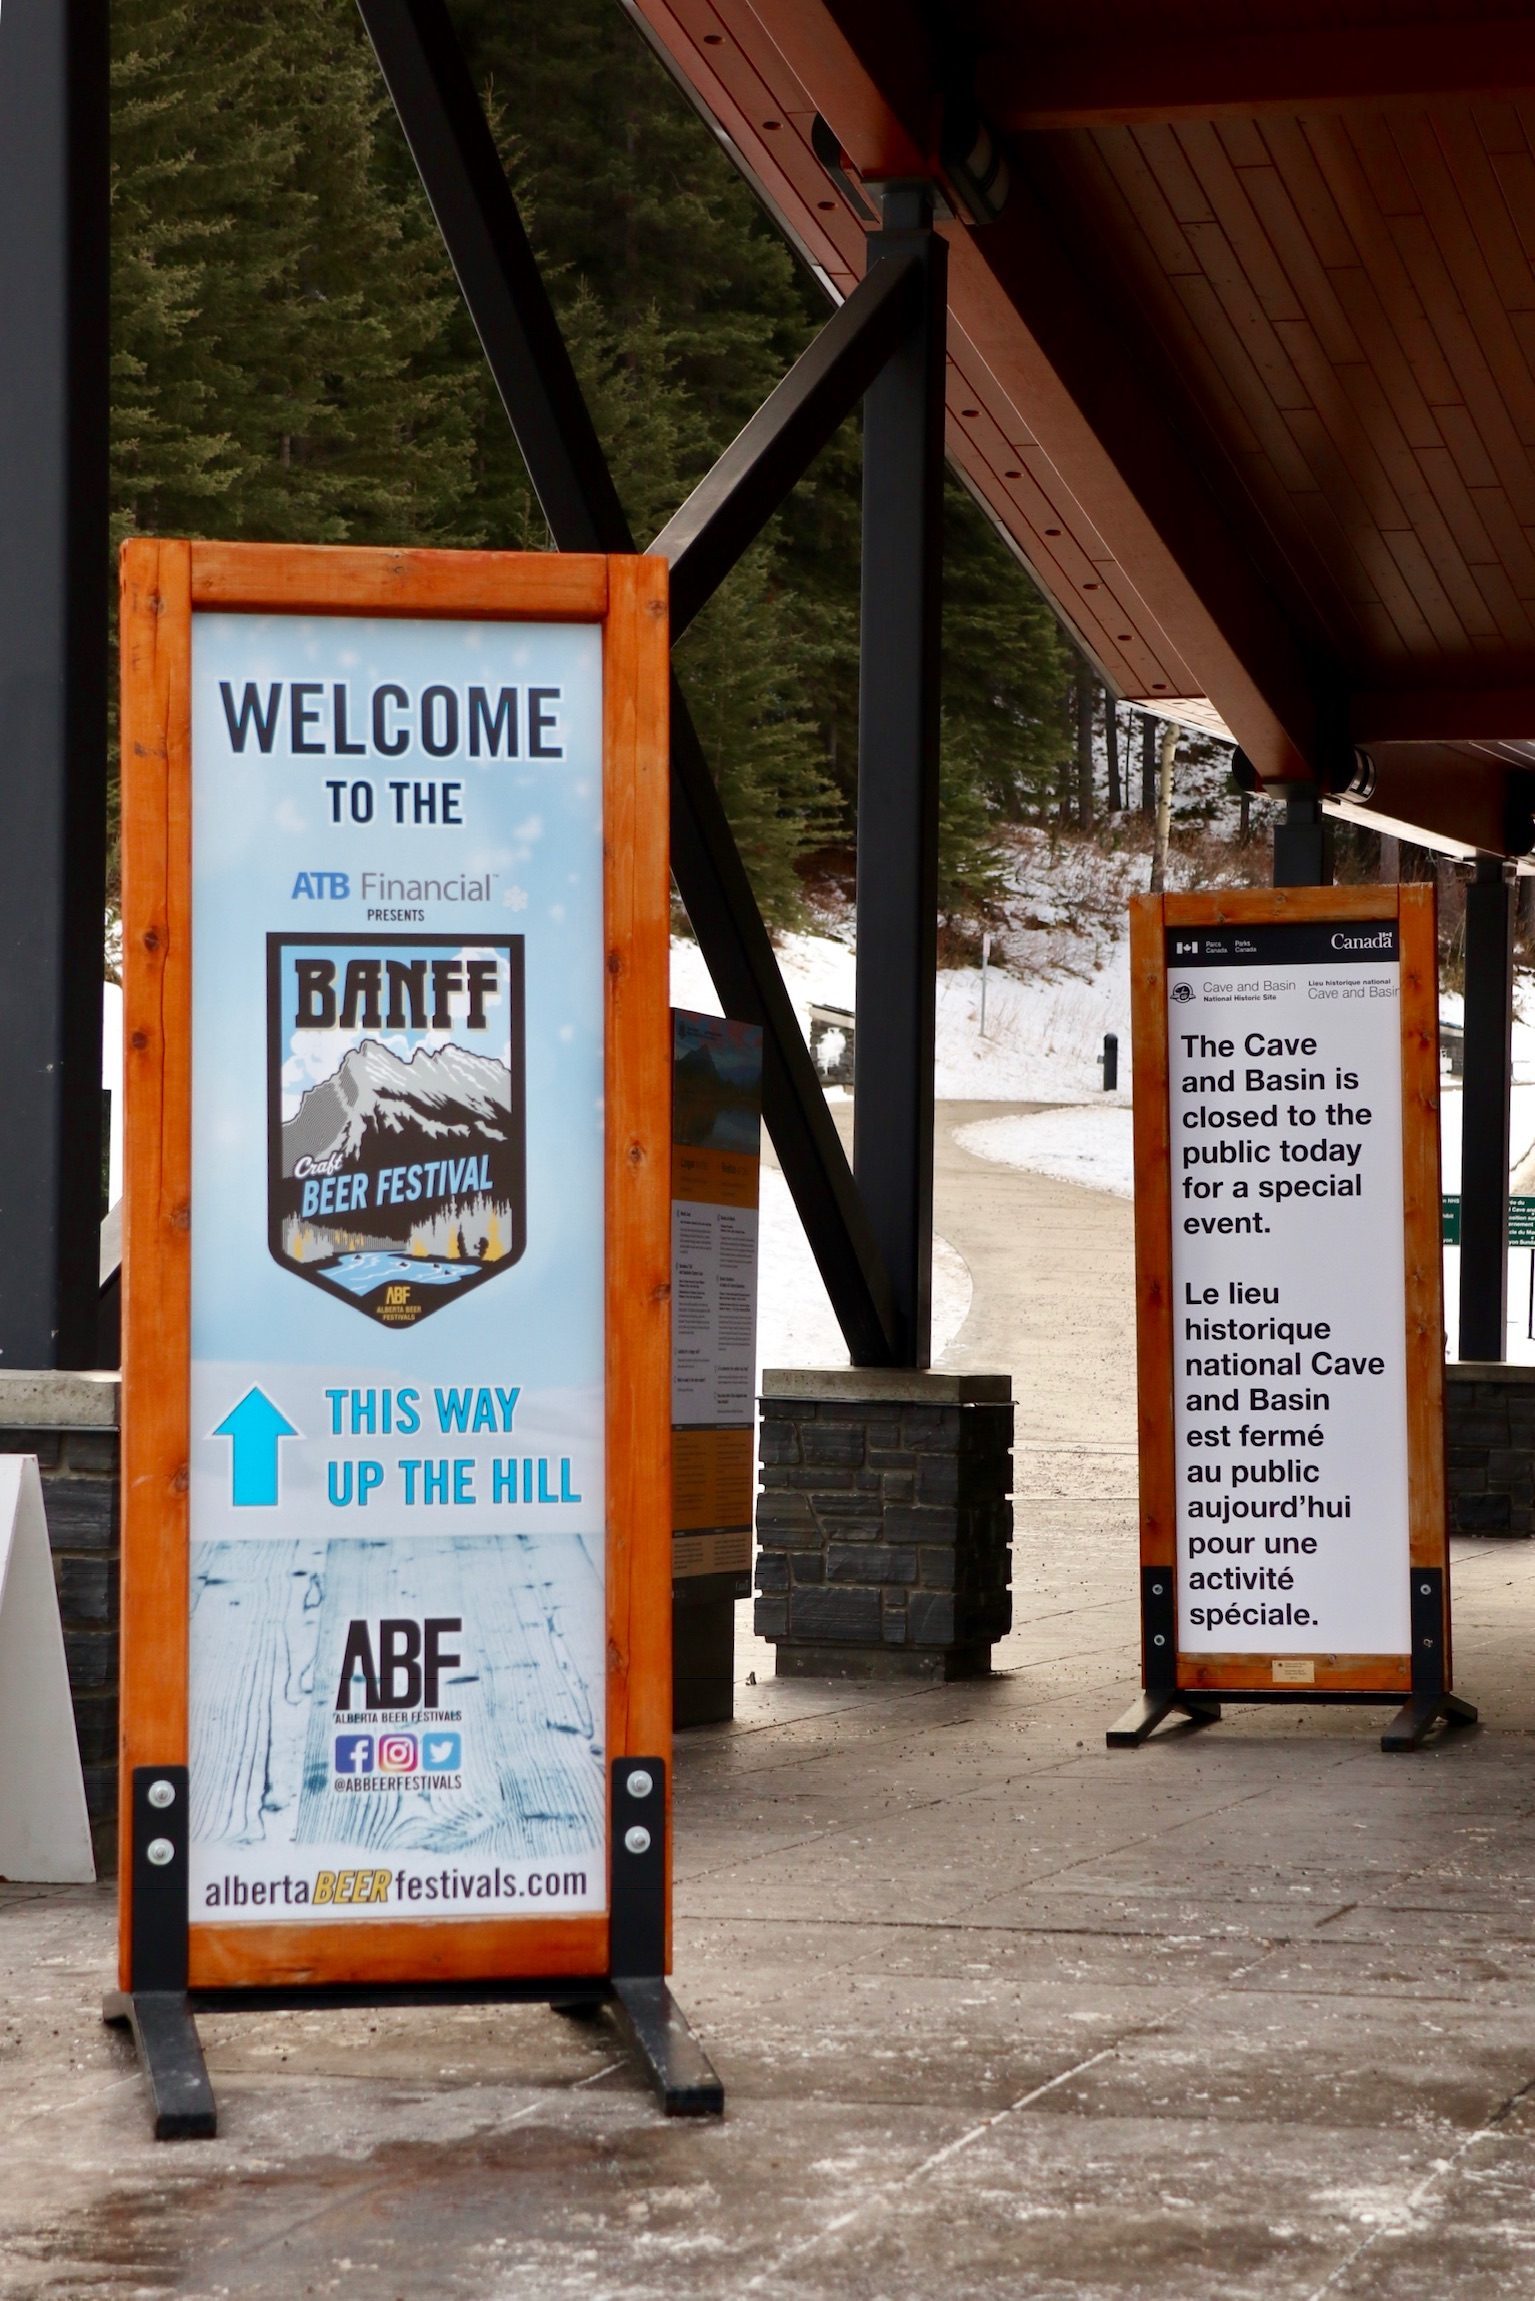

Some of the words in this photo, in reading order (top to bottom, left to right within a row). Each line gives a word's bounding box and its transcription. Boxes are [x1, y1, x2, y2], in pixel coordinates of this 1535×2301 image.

[219, 681, 565, 759] WELCOME
[326, 780, 374, 823] TO
[389, 781, 463, 825] THE
[291, 872, 350, 900] ATB
[367, 909, 425, 921] PRESENTS
[1205, 940, 1222, 948] Parcs
[1331, 932, 1392, 949] Canada
[294, 959, 499, 1031] BANFF
[1203, 982, 1233, 993] Cave
[1237, 981, 1259, 992] and
[1263, 980, 1296, 991] Basin
[1308, 988, 1339, 1000] Cave
[1342, 987, 1365, 998] and
[1326, 980, 1359, 988] historique
[1181, 1035, 1234, 1058] The
[1245, 1033, 1317, 1056] Cave
[1182, 1070, 1234, 1093] and
[1246, 1068, 1325, 1091] Basin
[1336, 1067, 1358, 1089] is
[1183, 1105, 1277, 1128] closed
[1287, 1106, 1315, 1126] to
[1326, 1103, 1372, 1125] the
[294, 1154, 343, 1178] Craft
[1183, 1140, 1270, 1169] public
[1280, 1139, 1362, 1166] today
[302, 1173, 368, 1218] BEER
[376, 1154, 493, 1206] FESTIVAL
[1182, 1177, 1223, 1198] for
[1233, 1181, 1248, 1198] a
[1259, 1174, 1361, 1202] special
[1184, 1213, 1270, 1234] event.
[386, 1286, 411, 1305] ABF
[1186, 1283, 1219, 1304] Le
[1230, 1282, 1278, 1304] lieu
[376, 1306, 405, 1314] ALBERTA
[405, 1305, 422, 1314] BEER
[1186, 1318, 1330, 1345] historique
[1186, 1352, 1300, 1376] national
[1312, 1352, 1384, 1375] Cave
[325, 1388, 420, 1435] THIS
[434, 1387, 521, 1433] WAY
[1186, 1389, 1238, 1411] and
[1250, 1388, 1329, 1410] Basin
[1187, 1426, 1230, 1447] est
[1239, 1424, 1324, 1446] fermé
[327, 1459, 384, 1507] UP
[398, 1458, 476, 1505] THE
[492, 1456, 581, 1504] HILL
[1187, 1465, 1221, 1483] au
[1232, 1460, 1319, 1488] public
[1189, 1537, 1255, 1559] pour
[1265, 1537, 1317, 1554] une
[1190, 1567, 1293, 1590] activité
[1190, 1603, 1317, 1631] spéciale.
[336, 1618, 462, 1710] ABF
[335, 1712, 378, 1724] ALBERTA
[381, 1712, 408, 1723] BEER
[411, 1710, 462, 1722] FESTIVALS
[334, 1775, 462, 1792] @ABBEERFESTIVALS
